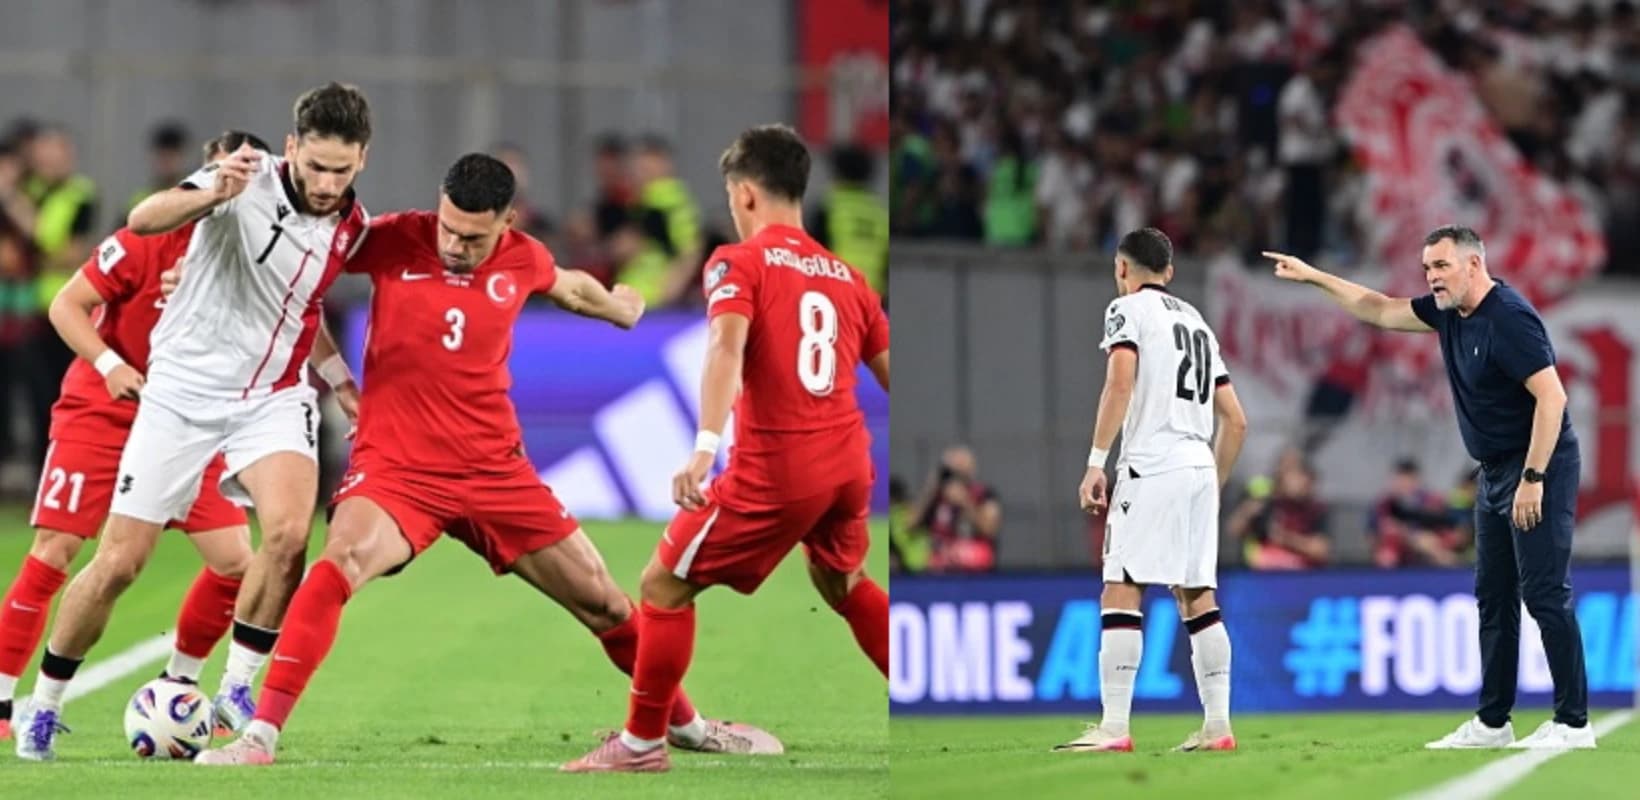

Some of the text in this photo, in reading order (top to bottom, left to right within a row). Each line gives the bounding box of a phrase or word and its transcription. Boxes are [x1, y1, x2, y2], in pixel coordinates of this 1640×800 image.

[256, 223, 283, 265] 7
[442, 307, 466, 351] 3
[797, 290, 838, 396] 8
[1173, 322, 1212, 405] 20
[43, 467, 86, 514] 21
[1036, 598, 1184, 700] AL
